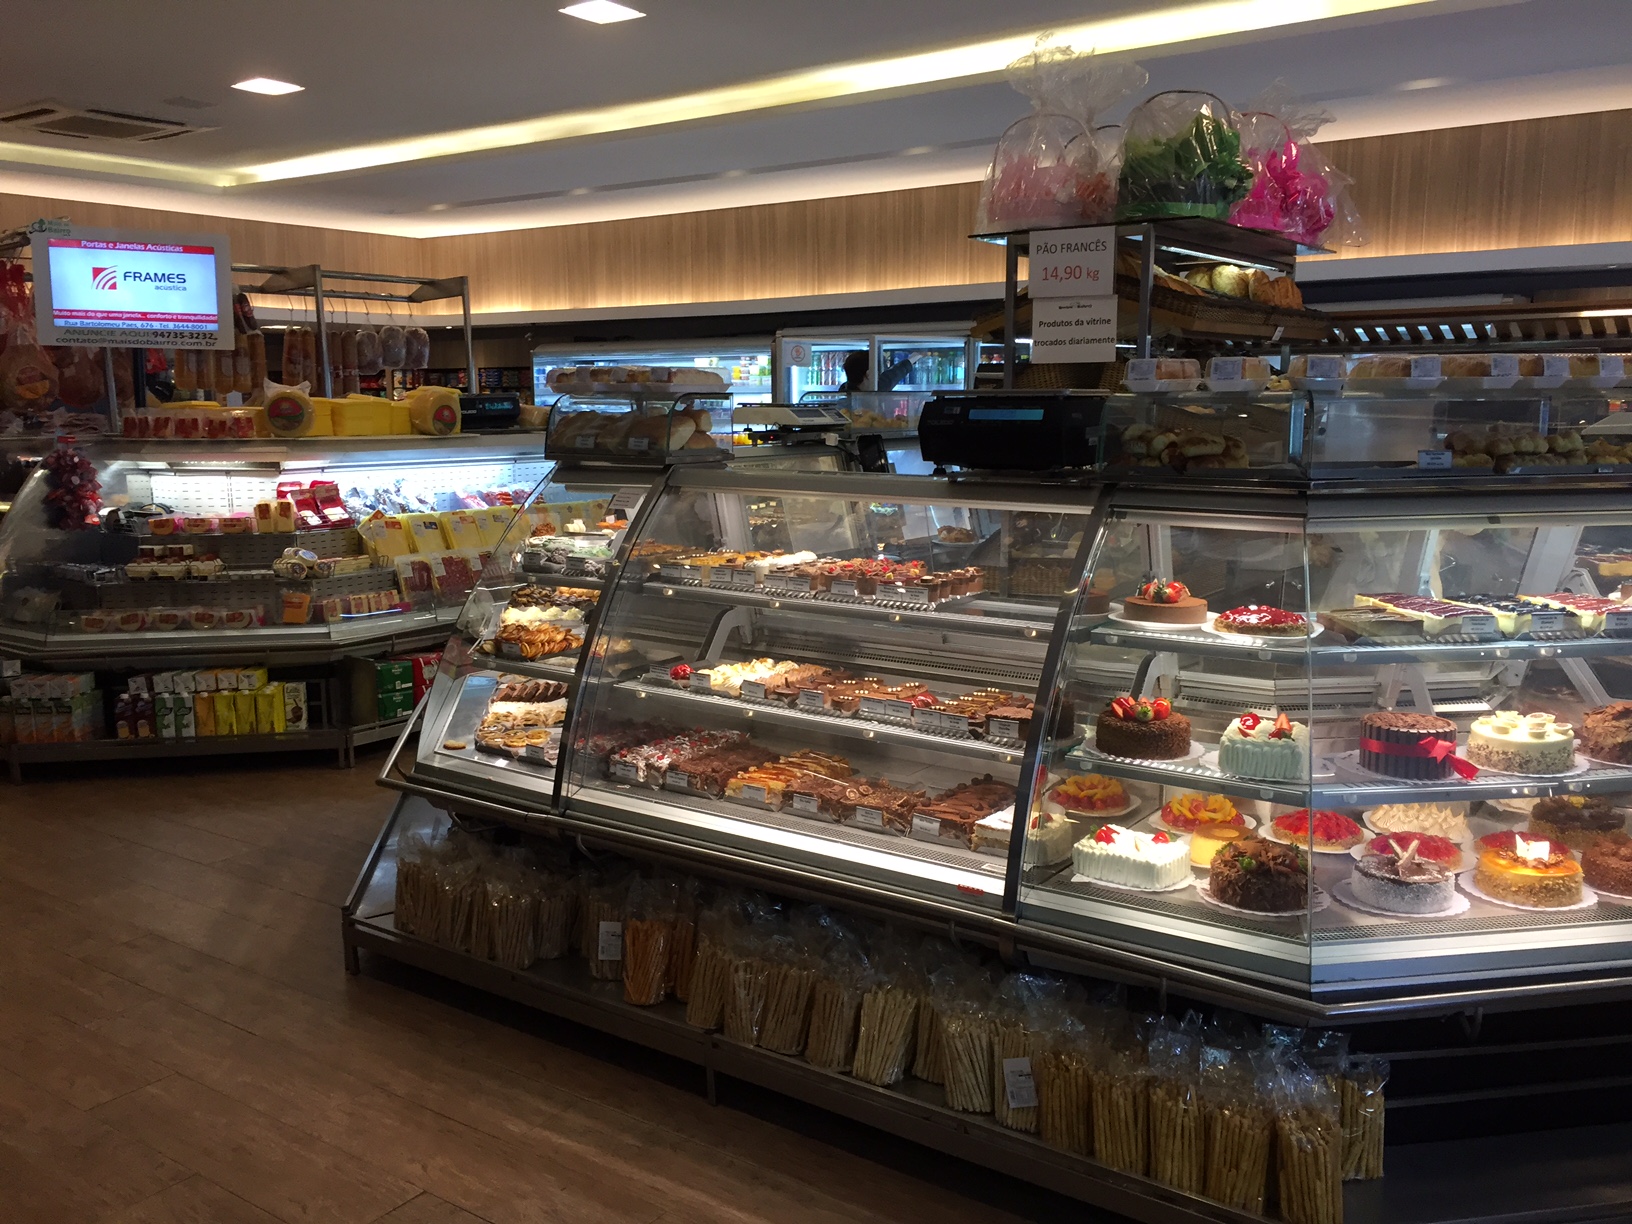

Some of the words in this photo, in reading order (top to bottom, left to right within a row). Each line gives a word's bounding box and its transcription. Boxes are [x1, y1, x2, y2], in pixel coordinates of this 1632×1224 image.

[81, 240, 107, 249] Portas
[115, 241, 145, 251] Janelas
[146, 243, 183, 252] Acústicas
[1036, 242, 1058, 255] PÃO
[1060, 239, 1107, 253] FRANCÊS
[123, 271, 187, 284] FRAMES
[1042, 265, 1083, 283] 14,90
[1086, 267, 1100, 282] kg
[1038, 318, 1073, 328] Produtos
[1075, 318, 1085, 327] da
[1086, 317, 1112, 326] vitrine
[63, 329, 117, 337] ANUNCIE
[1034, 337, 1067, 347] trocados
[1068, 336, 1116, 346] diariamente
